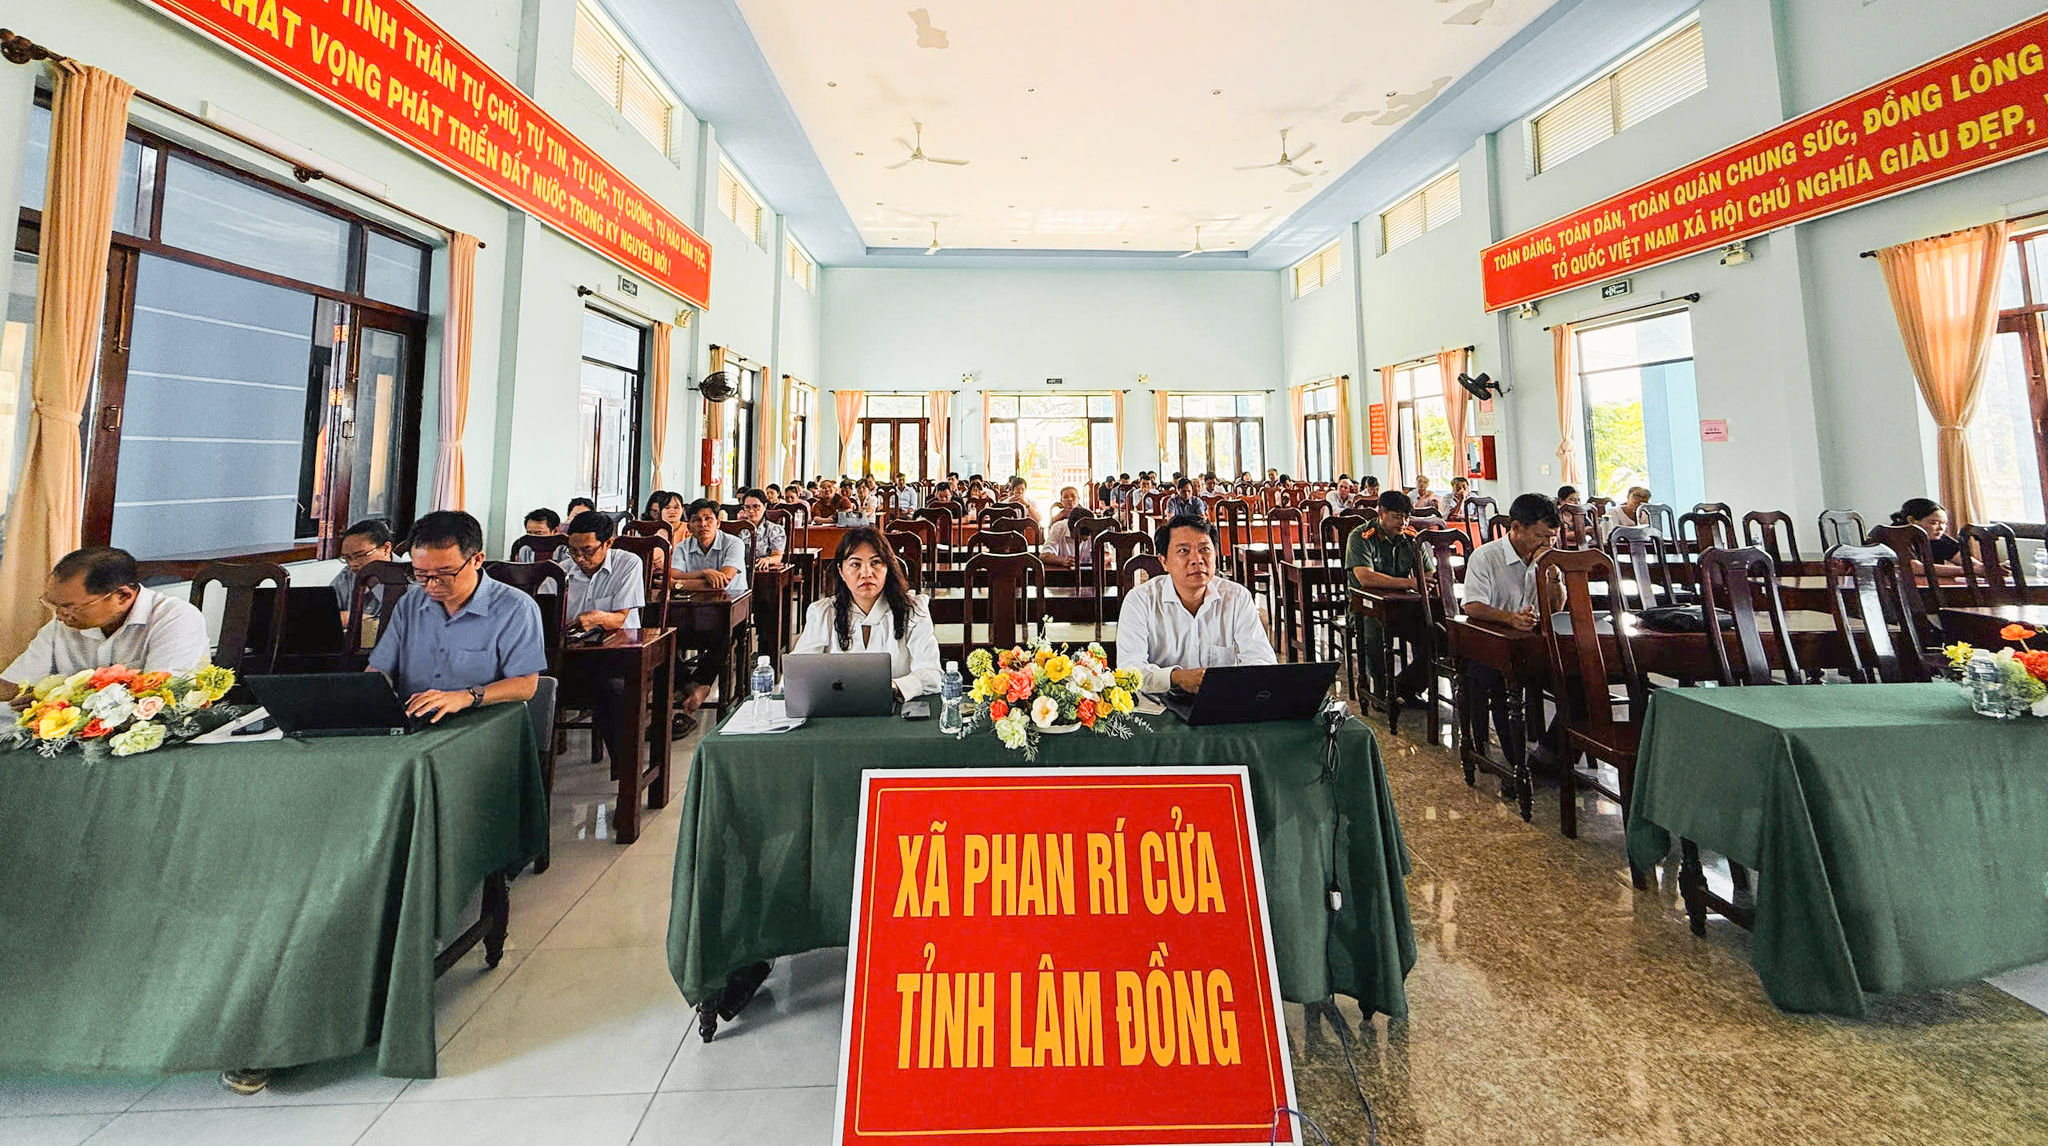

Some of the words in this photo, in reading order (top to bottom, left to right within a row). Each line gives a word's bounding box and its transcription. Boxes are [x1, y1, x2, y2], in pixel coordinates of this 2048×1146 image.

[310, 24, 382, 101] VỌNG
[387, 76, 443, 136] PHÁT
[448, 115, 498, 171] TRIỂN
[501, 150, 530, 189] ĐẤT
[533, 171, 567, 213] NƯỚC
[569, 195, 604, 236] TRONG
[403, 27, 457, 92] THẦN
[462, 72, 485, 118] TỰ
[487, 93, 522, 144] CHỦ,
[526, 121, 545, 159] TỰ
[547, 136, 569, 177] TIN,
[572, 155, 588, 189] TỰ
[589, 170, 609, 205] LỰC,
[612, 186, 625, 216] TỰ
[656, 219, 666, 245] TỰ
[1494, 247, 1520, 272] TOÀN
[1557, 221, 1591, 248] TOÀN
[1593, 209, 1626, 236] DÂN,
[1629, 190, 1670, 222] TOÀN
[1674, 169, 1722, 205] QUÂN
[1726, 141, 1797, 186] CHUNG
[1802, 119, 1857, 158] SỨC,
[1863, 84, 1943, 135] ĐỒNG
[1951, 43, 2044, 102] LÒNG
[1552, 252, 1568, 280] TỔ
[1570, 243, 1605, 274] QUỐC
[1608, 235, 1640, 263] VIỆT
[1645, 222, 1679, 252] NAM
[1683, 209, 1706, 239] XÃ
[1710, 199, 1743, 231] HỘI
[1748, 177, 1791, 218] CHỦ
[1796, 154, 1874, 203] NGHĨA
[1880, 128, 1949, 175] GIÀU
[1957, 104, 2036, 150] ĐẸP,
[893, 820, 950, 917] XÃ
[963, 833, 1075, 917] PHAN
[1087, 817, 1129, 914] RÍ
[1140, 806, 1226, 914] CỬA
[896, 942, 995, 1069] TỈNH
[1010, 953, 1104, 1067] LÂM
[1115, 942, 1242, 1067] ĐỒNG
